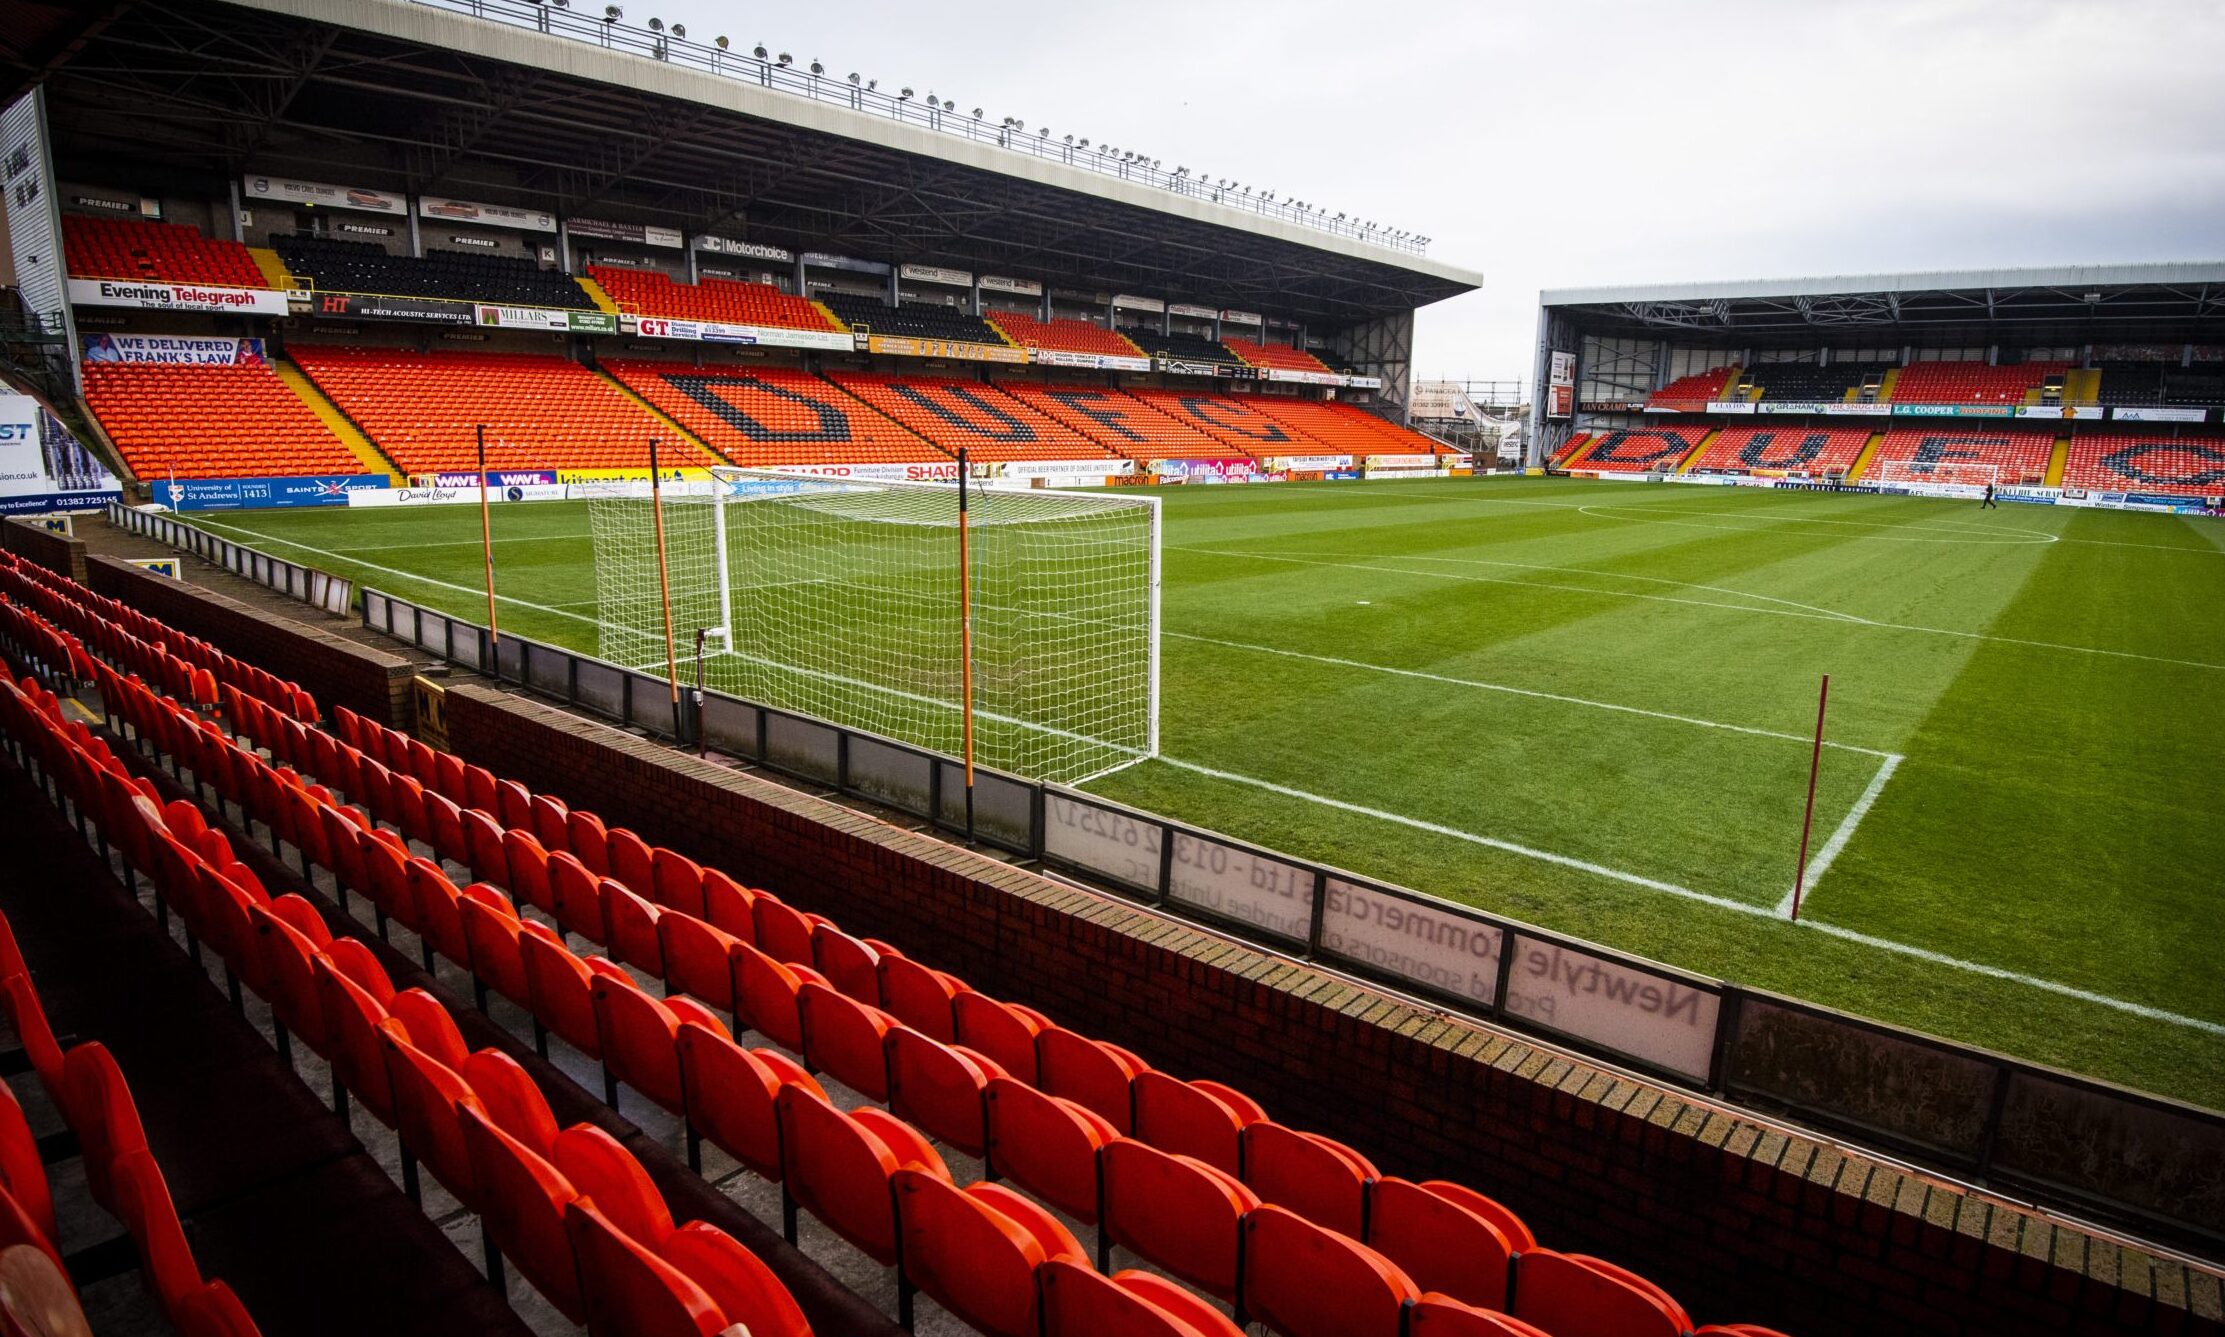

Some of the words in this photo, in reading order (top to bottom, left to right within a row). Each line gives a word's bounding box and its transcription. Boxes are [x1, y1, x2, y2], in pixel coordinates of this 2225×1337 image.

[79, 198, 130, 210] PREMIER
[344, 225, 388, 236] PREMIER
[455, 237, 495, 247] PREMIER
[544, 250, 551, 258] K
[726, 239, 788, 260] Motorchoice
[100, 283, 170, 303] Evening
[172, 287, 256, 307] Telegraph
[141, 301, 156, 309] The
[184, 303, 203, 311] local
[322, 297, 350, 313] HT
[361, 308, 392, 316] HI-TECH
[392, 310, 426, 318] ACOUSTIC
[426, 311, 458, 320] SERVICES
[501, 309, 548, 321] MILLARS
[640, 319, 670, 336] G.T.
[757, 329, 784, 339] Norman
[786, 331, 817, 341] Jamieson
[117, 337, 144, 350] WE
[148, 338, 233, 352] DELIVERED
[126, 352, 192, 363] FRANK'S
[197, 353, 232, 365] LAW
[1894, 405, 1912, 414] L.G.
[1914, 406, 1954, 415] COOPER
[854, 466, 880, 474] Furniture
[881, 466, 904, 474] Division
[1017, 465, 1037, 474] OFFICIAL
[1050, 465, 1069, 473] PARTNER
[1076, 464, 1092, 472] DUNDEE
[1093, 464, 1107, 472] UNITED
[1107, 464, 1114, 472] FC
[1191, 463, 1216, 476] utilita
[1225, 463, 1250, 475] utilita
[1114, 475, 1149, 487] macron
[186, 484, 222, 492] University
[223, 483, 232, 491] of
[742, 484, 766, 494] Living
[776, 484, 794, 493] style
[187, 492, 198, 500] St
[199, 491, 238, 500] Andrews
[243, 489, 268, 499] 1413
[398, 489, 431, 501] David
[432, 488, 456, 501] Lloyd
[56, 498, 85, 506] 01382
